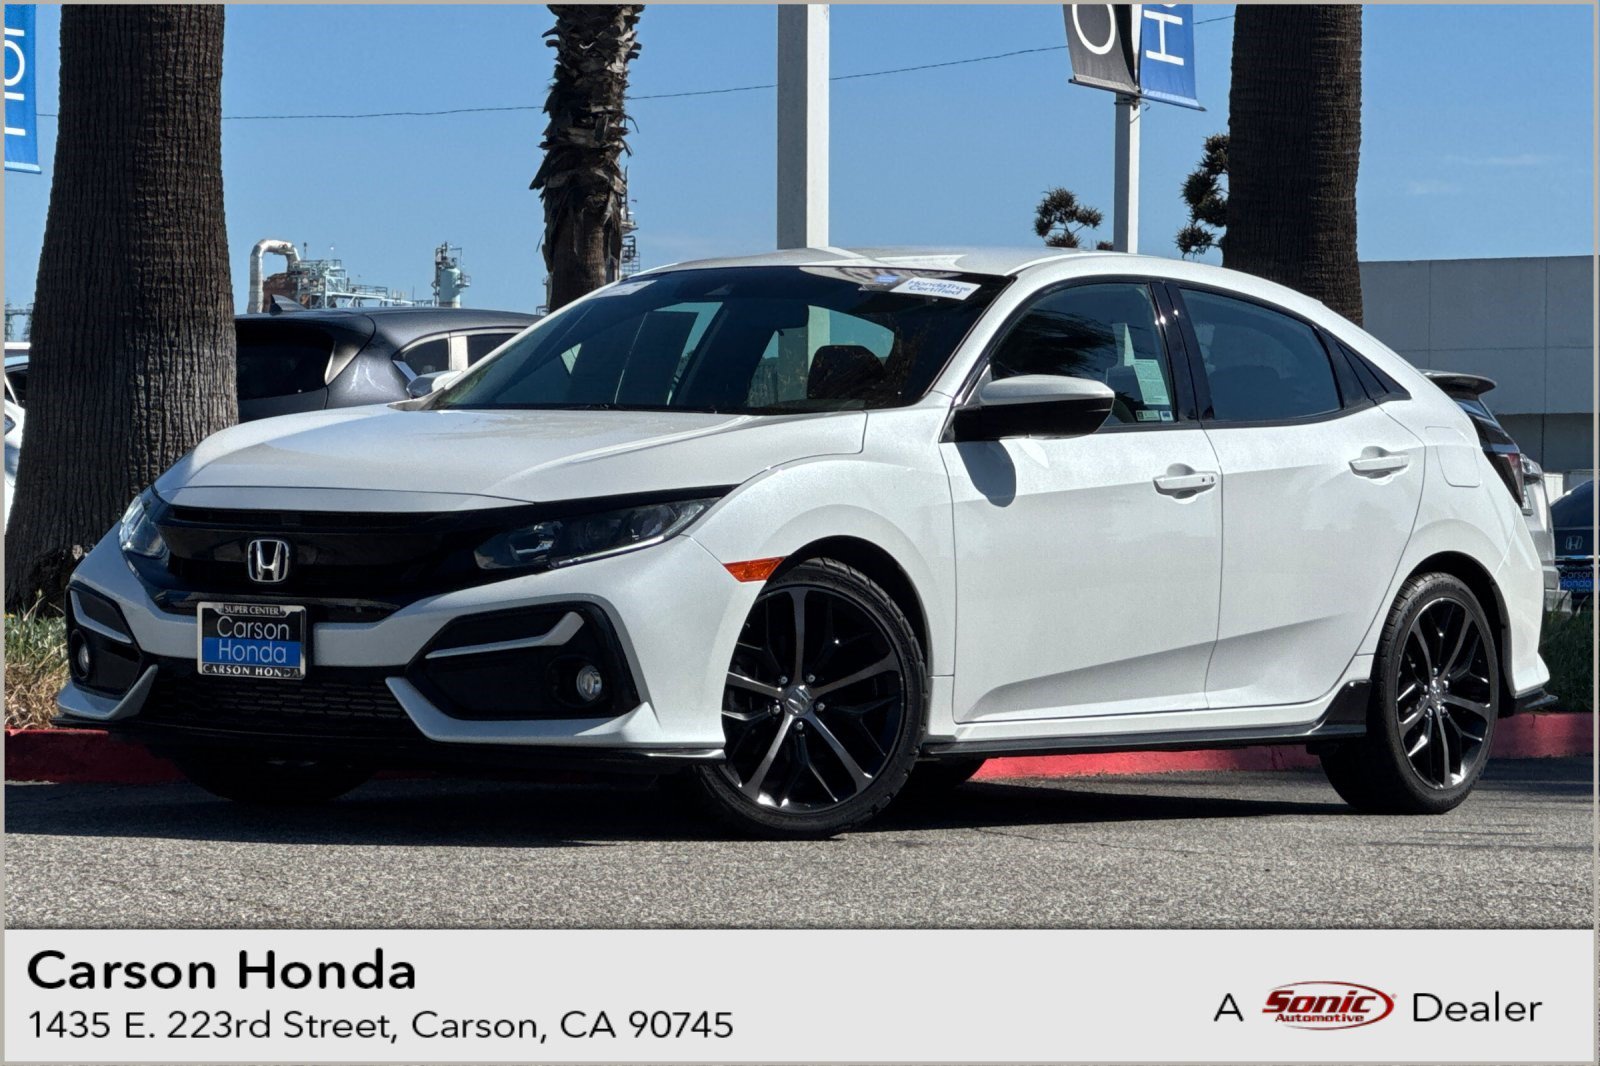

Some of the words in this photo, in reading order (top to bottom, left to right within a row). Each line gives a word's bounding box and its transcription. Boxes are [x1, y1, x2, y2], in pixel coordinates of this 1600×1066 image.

[224, 605, 249, 614] SUPER
[249, 606, 279, 615] CENTER
[217, 616, 290, 640] Carson
[219, 640, 287, 663] Honda
[203, 664, 250, 675] CARSON
[255, 665, 300, 677] HONDA
